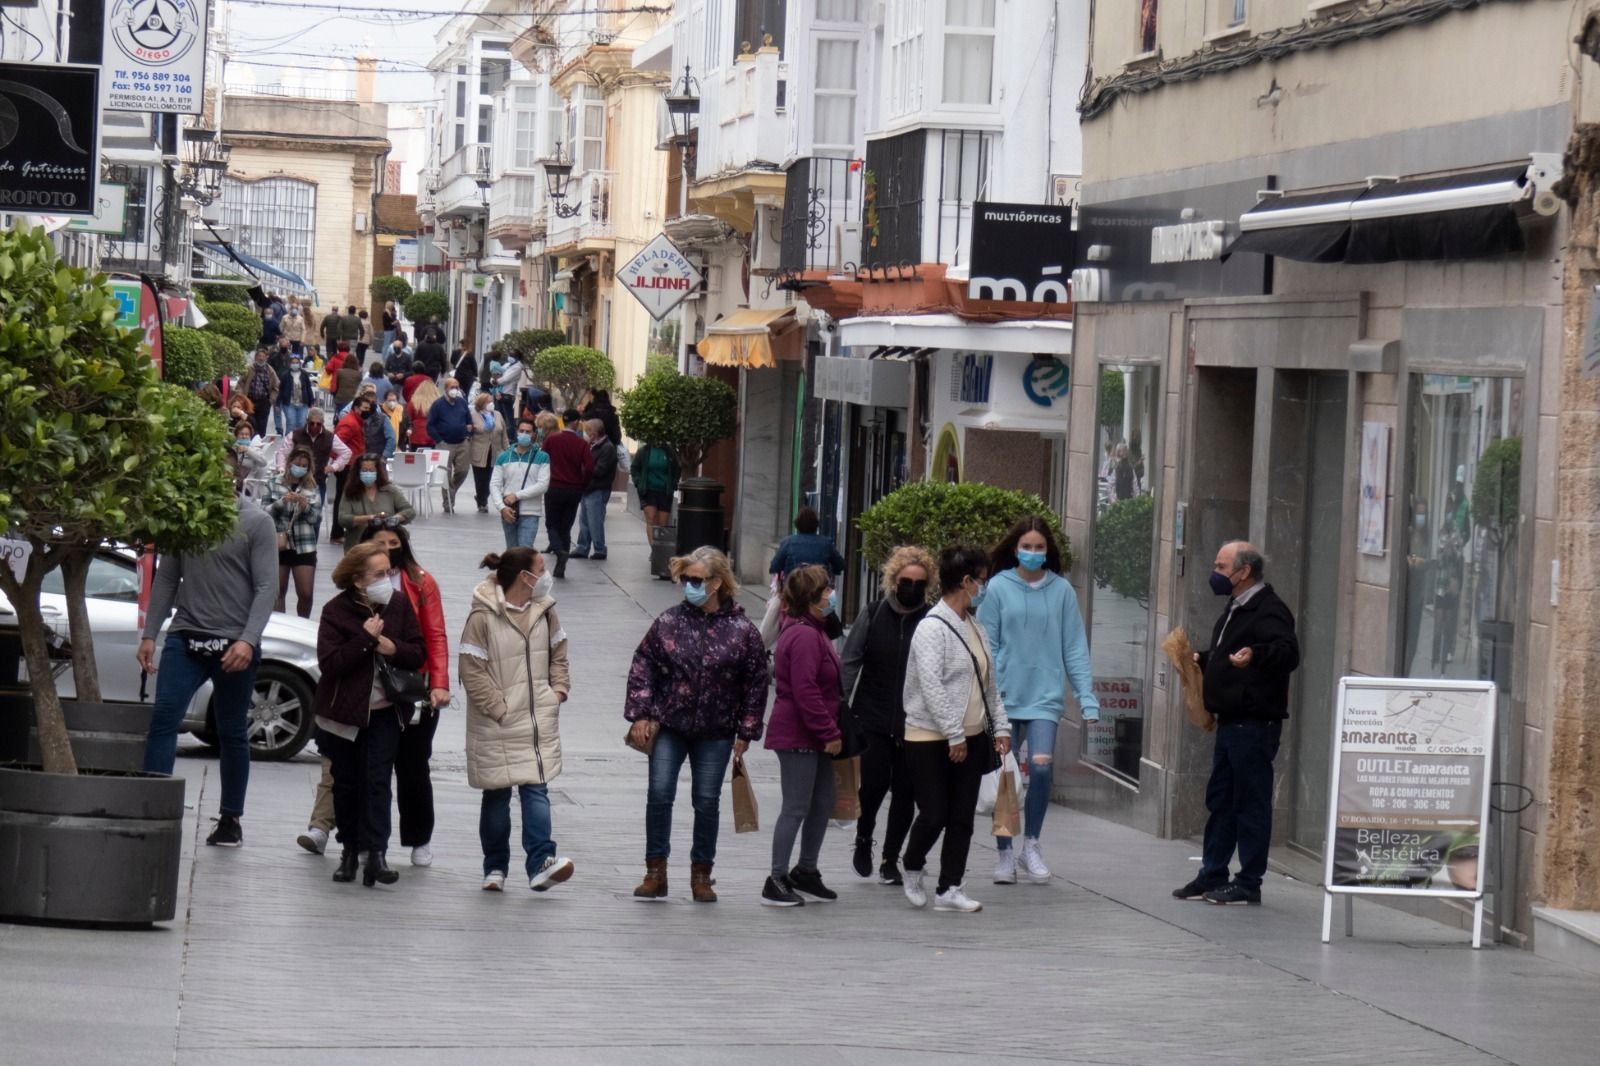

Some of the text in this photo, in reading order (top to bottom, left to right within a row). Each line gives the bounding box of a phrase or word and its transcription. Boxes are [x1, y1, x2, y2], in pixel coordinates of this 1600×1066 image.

[135, 47, 170, 59] DIEGO
[115, 70, 190, 82] Tlf. 956 889 304
[112, 81, 192, 93] Fax: 956 597 160
[109, 93, 146, 101] PERMISOS
[144, 102, 192, 111] CICLOMOTOR
[630, 275, 690, 290] JIJONA
[1348, 707, 1377, 716] Nueva
[1341, 730, 1417, 745] amarantta
[1369, 786, 1389, 797] ROPA
[1397, 787, 1455, 799] COMPLEMENTOS
[1357, 828, 1420, 845] Belleza
[1370, 844, 1440, 861] Estética
